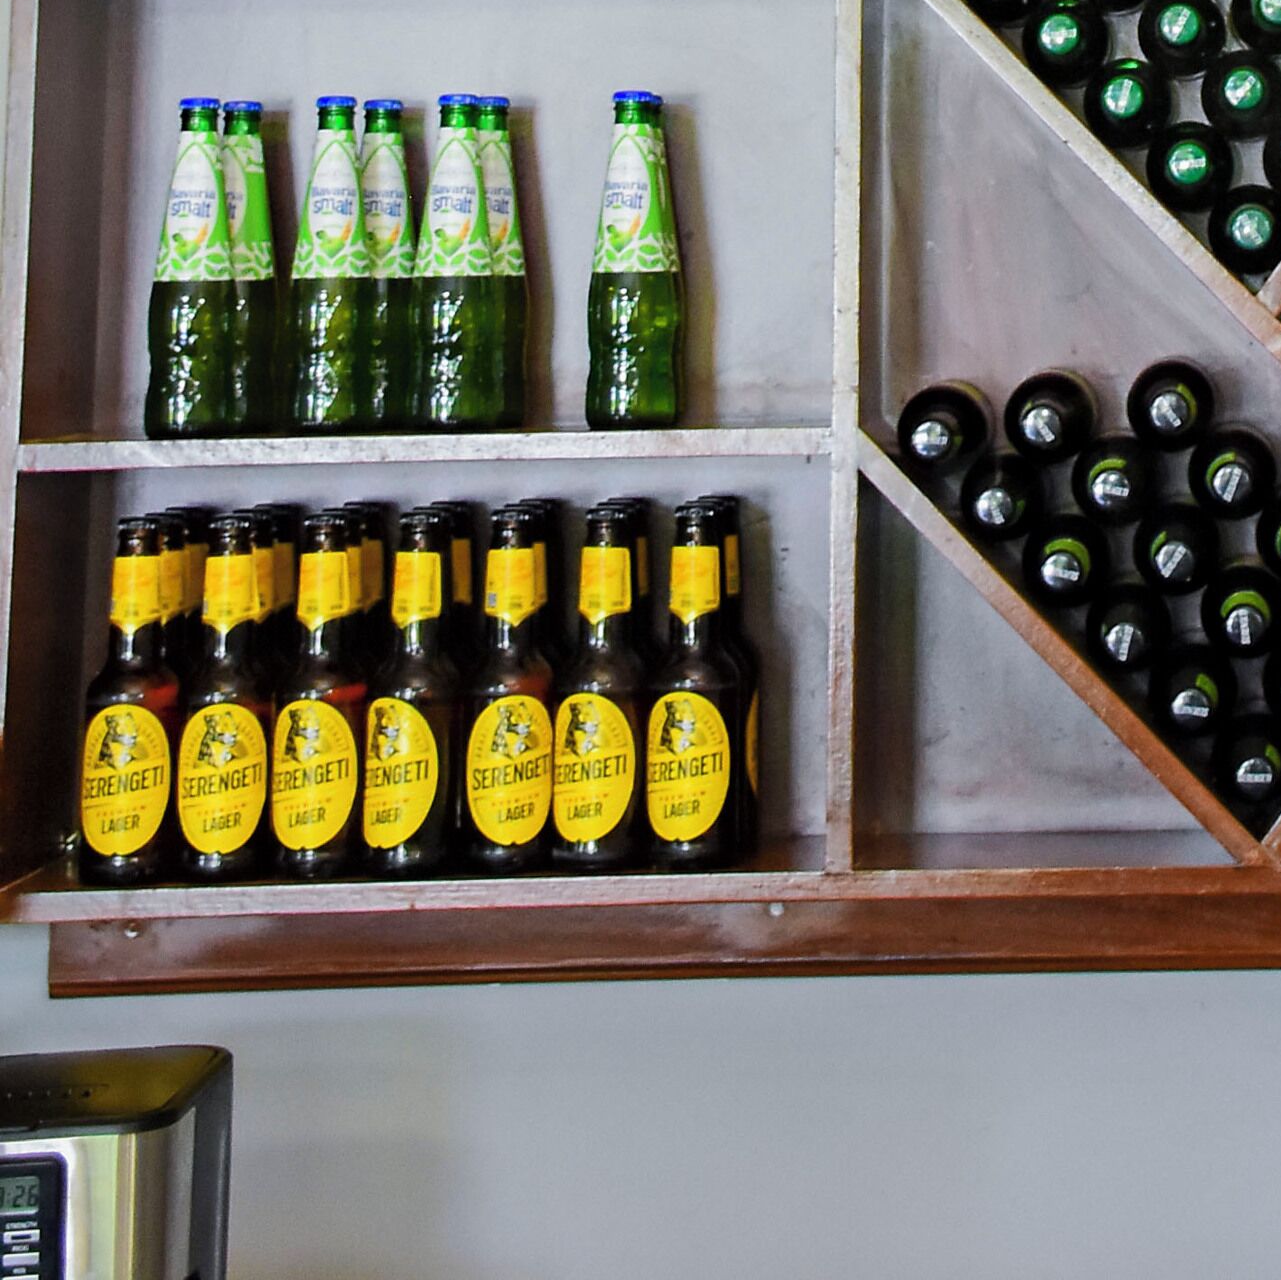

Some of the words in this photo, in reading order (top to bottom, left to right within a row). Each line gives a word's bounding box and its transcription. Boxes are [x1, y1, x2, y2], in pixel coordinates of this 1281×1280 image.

[171, 200, 211, 218] smalt
[288, 807, 326, 828] LAGER
[498, 802, 536, 823] LAGER
[567, 802, 603, 821] LAGER
[663, 799, 700, 819] LAGER
[101, 814, 140, 834] LAGER
[203, 811, 242, 833] LAGER
